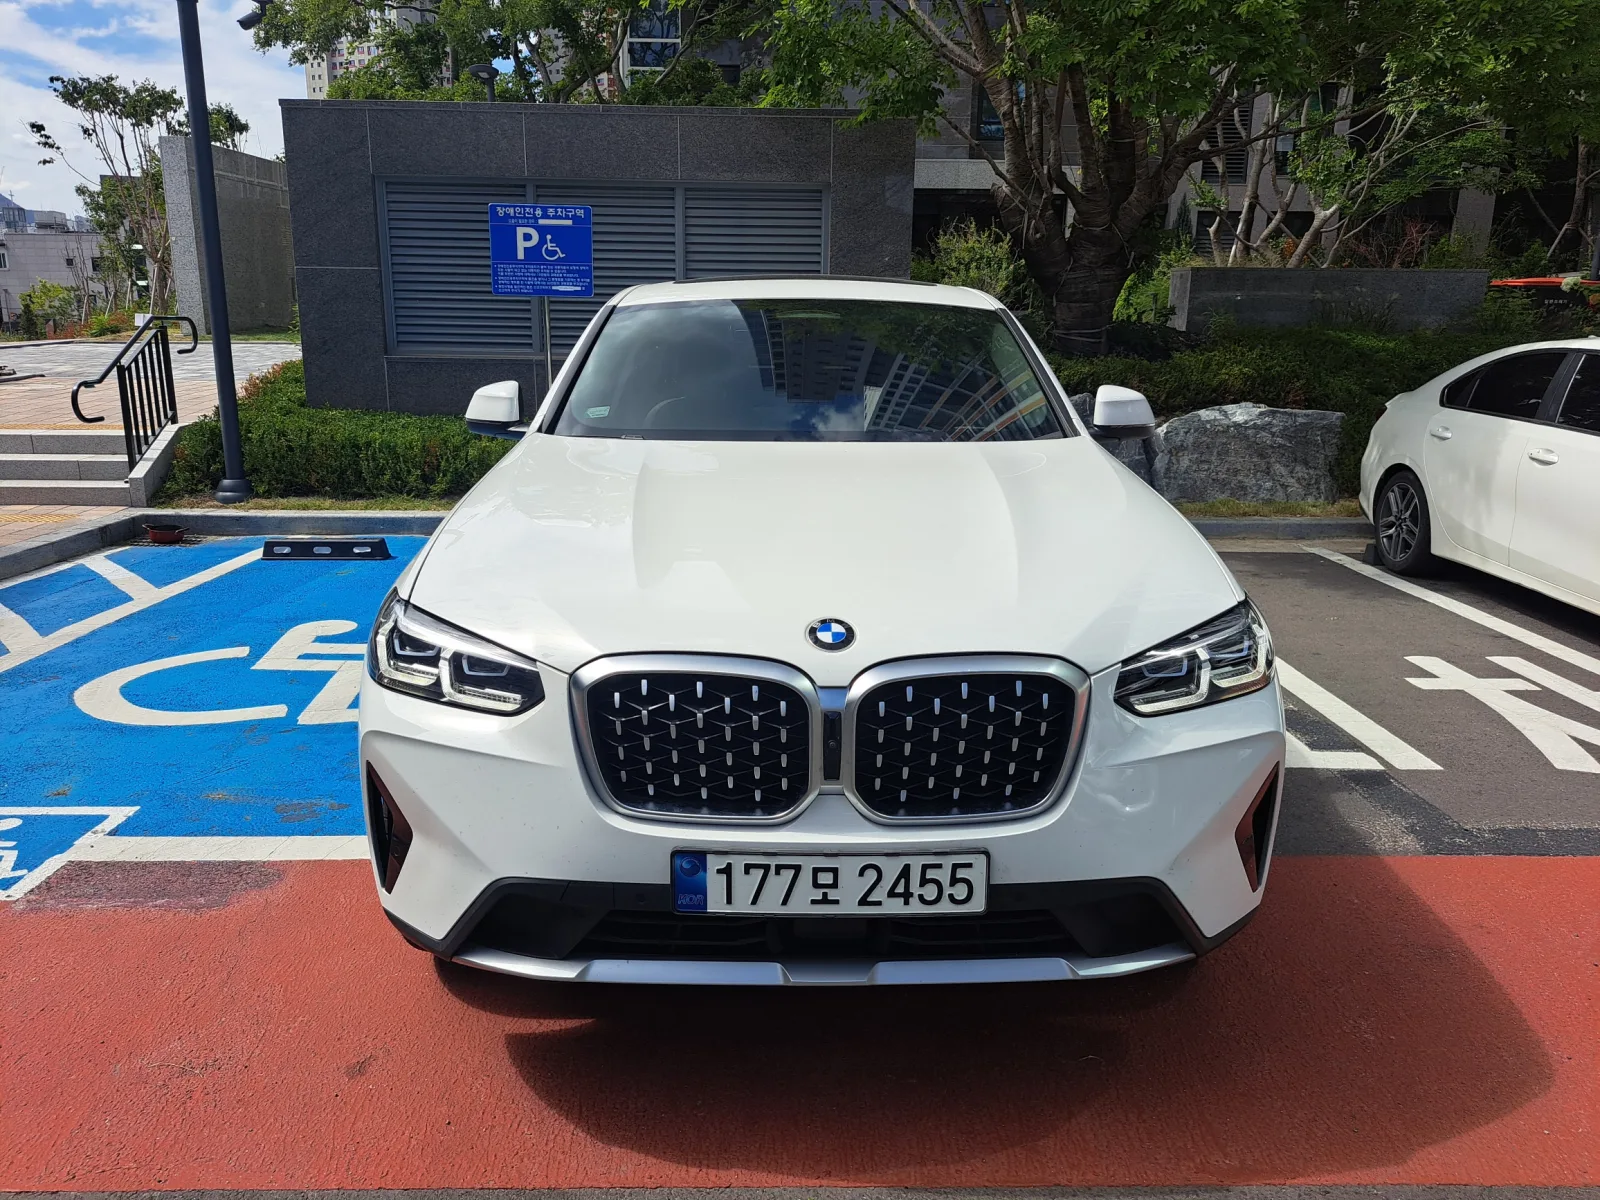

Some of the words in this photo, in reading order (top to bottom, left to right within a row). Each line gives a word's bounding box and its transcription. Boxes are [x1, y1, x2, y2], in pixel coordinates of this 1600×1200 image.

[496, 206, 542, 218] 장애인전용
[547, 208, 584, 218] 주차구역
[516, 226, 540, 260] P
[715, 861, 840, 906] 177모
[857, 862, 974, 907] 2455
[677, 893, 705, 906] KOR
